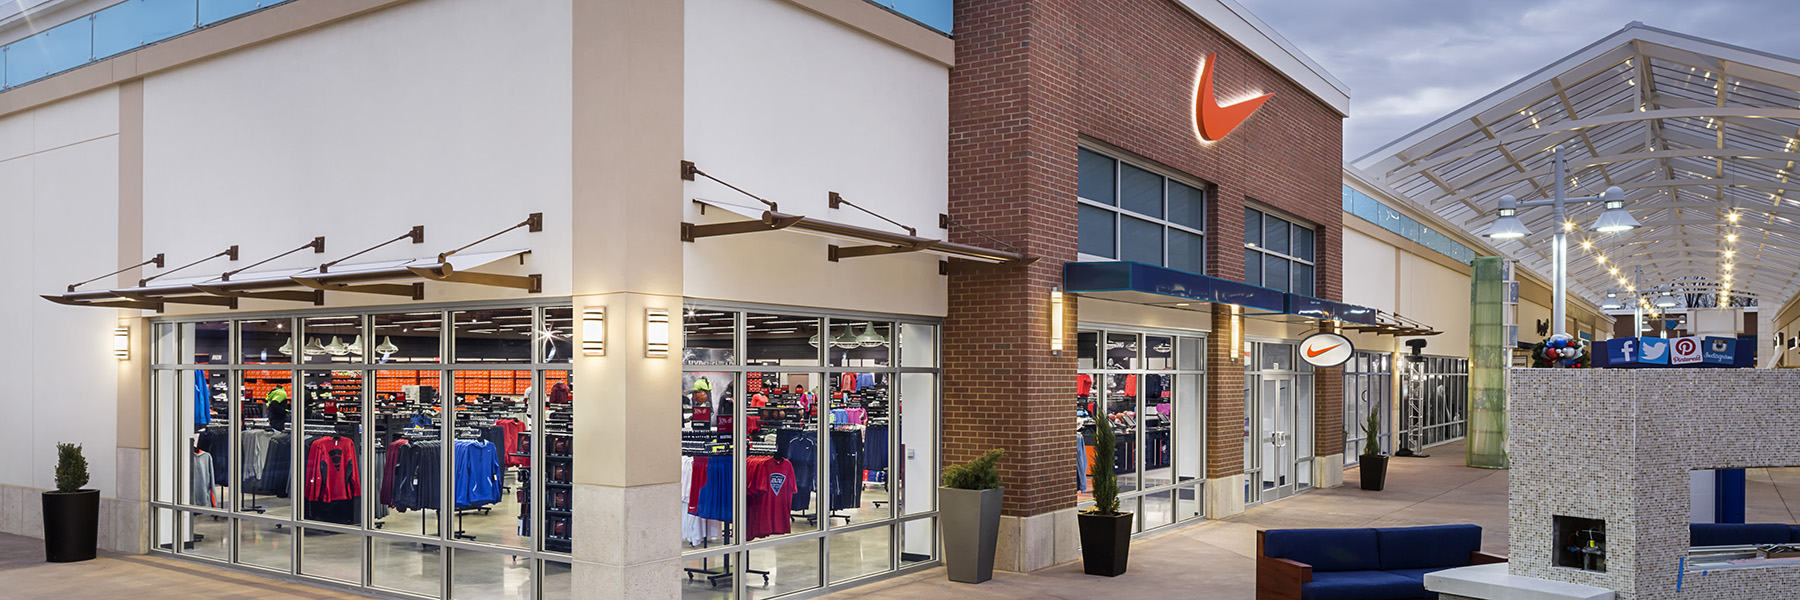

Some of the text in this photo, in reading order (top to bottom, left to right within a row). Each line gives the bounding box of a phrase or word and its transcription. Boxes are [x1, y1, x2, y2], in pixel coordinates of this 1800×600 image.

[1621, 340, 1633, 361] f
[1673, 354, 1701, 363] Pinterest
[1703, 351, 1733, 362] Instagram
